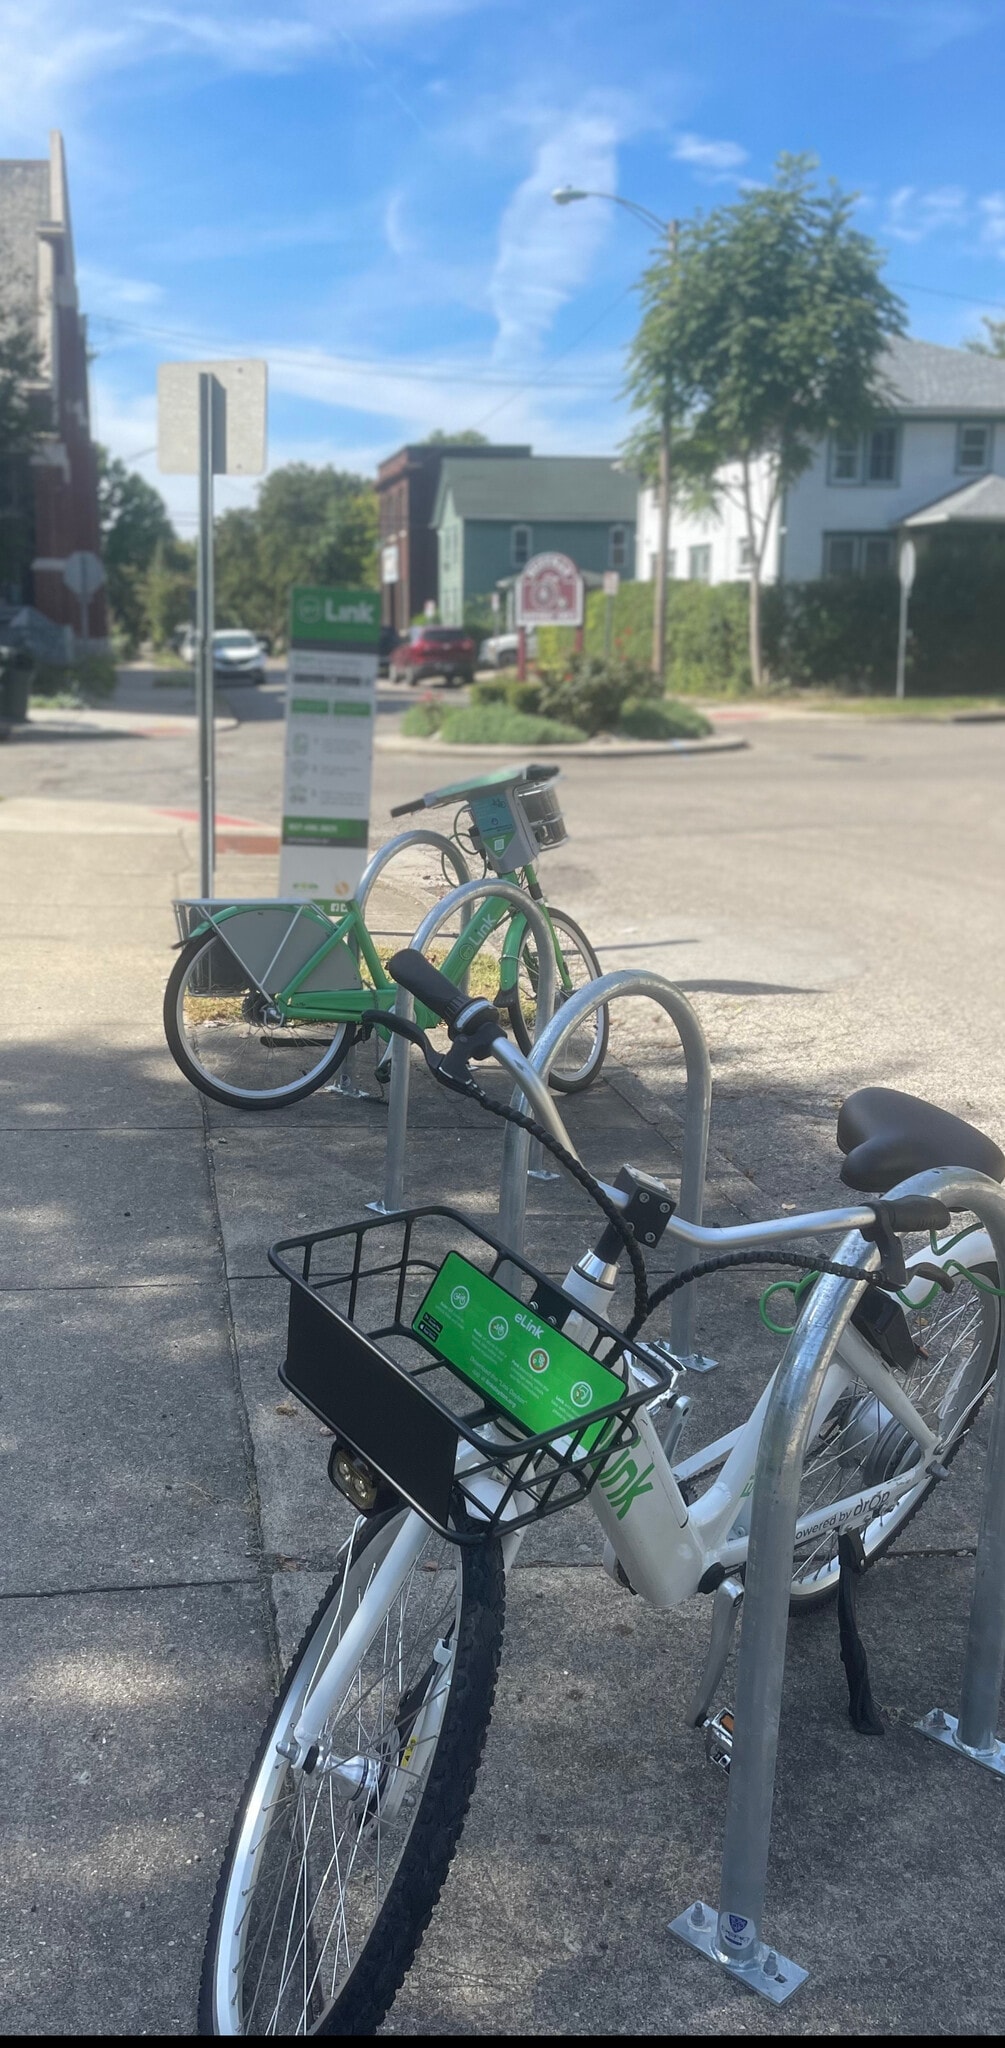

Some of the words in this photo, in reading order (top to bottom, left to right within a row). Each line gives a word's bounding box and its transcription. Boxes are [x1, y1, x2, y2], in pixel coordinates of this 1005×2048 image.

[324, 598, 375, 624] Link
[468, 914, 497, 946] Link
[514, 1312, 545, 1340] eLink
[795, 1514, 837, 1539] owered
[839, 1511, 852, 1522] by
